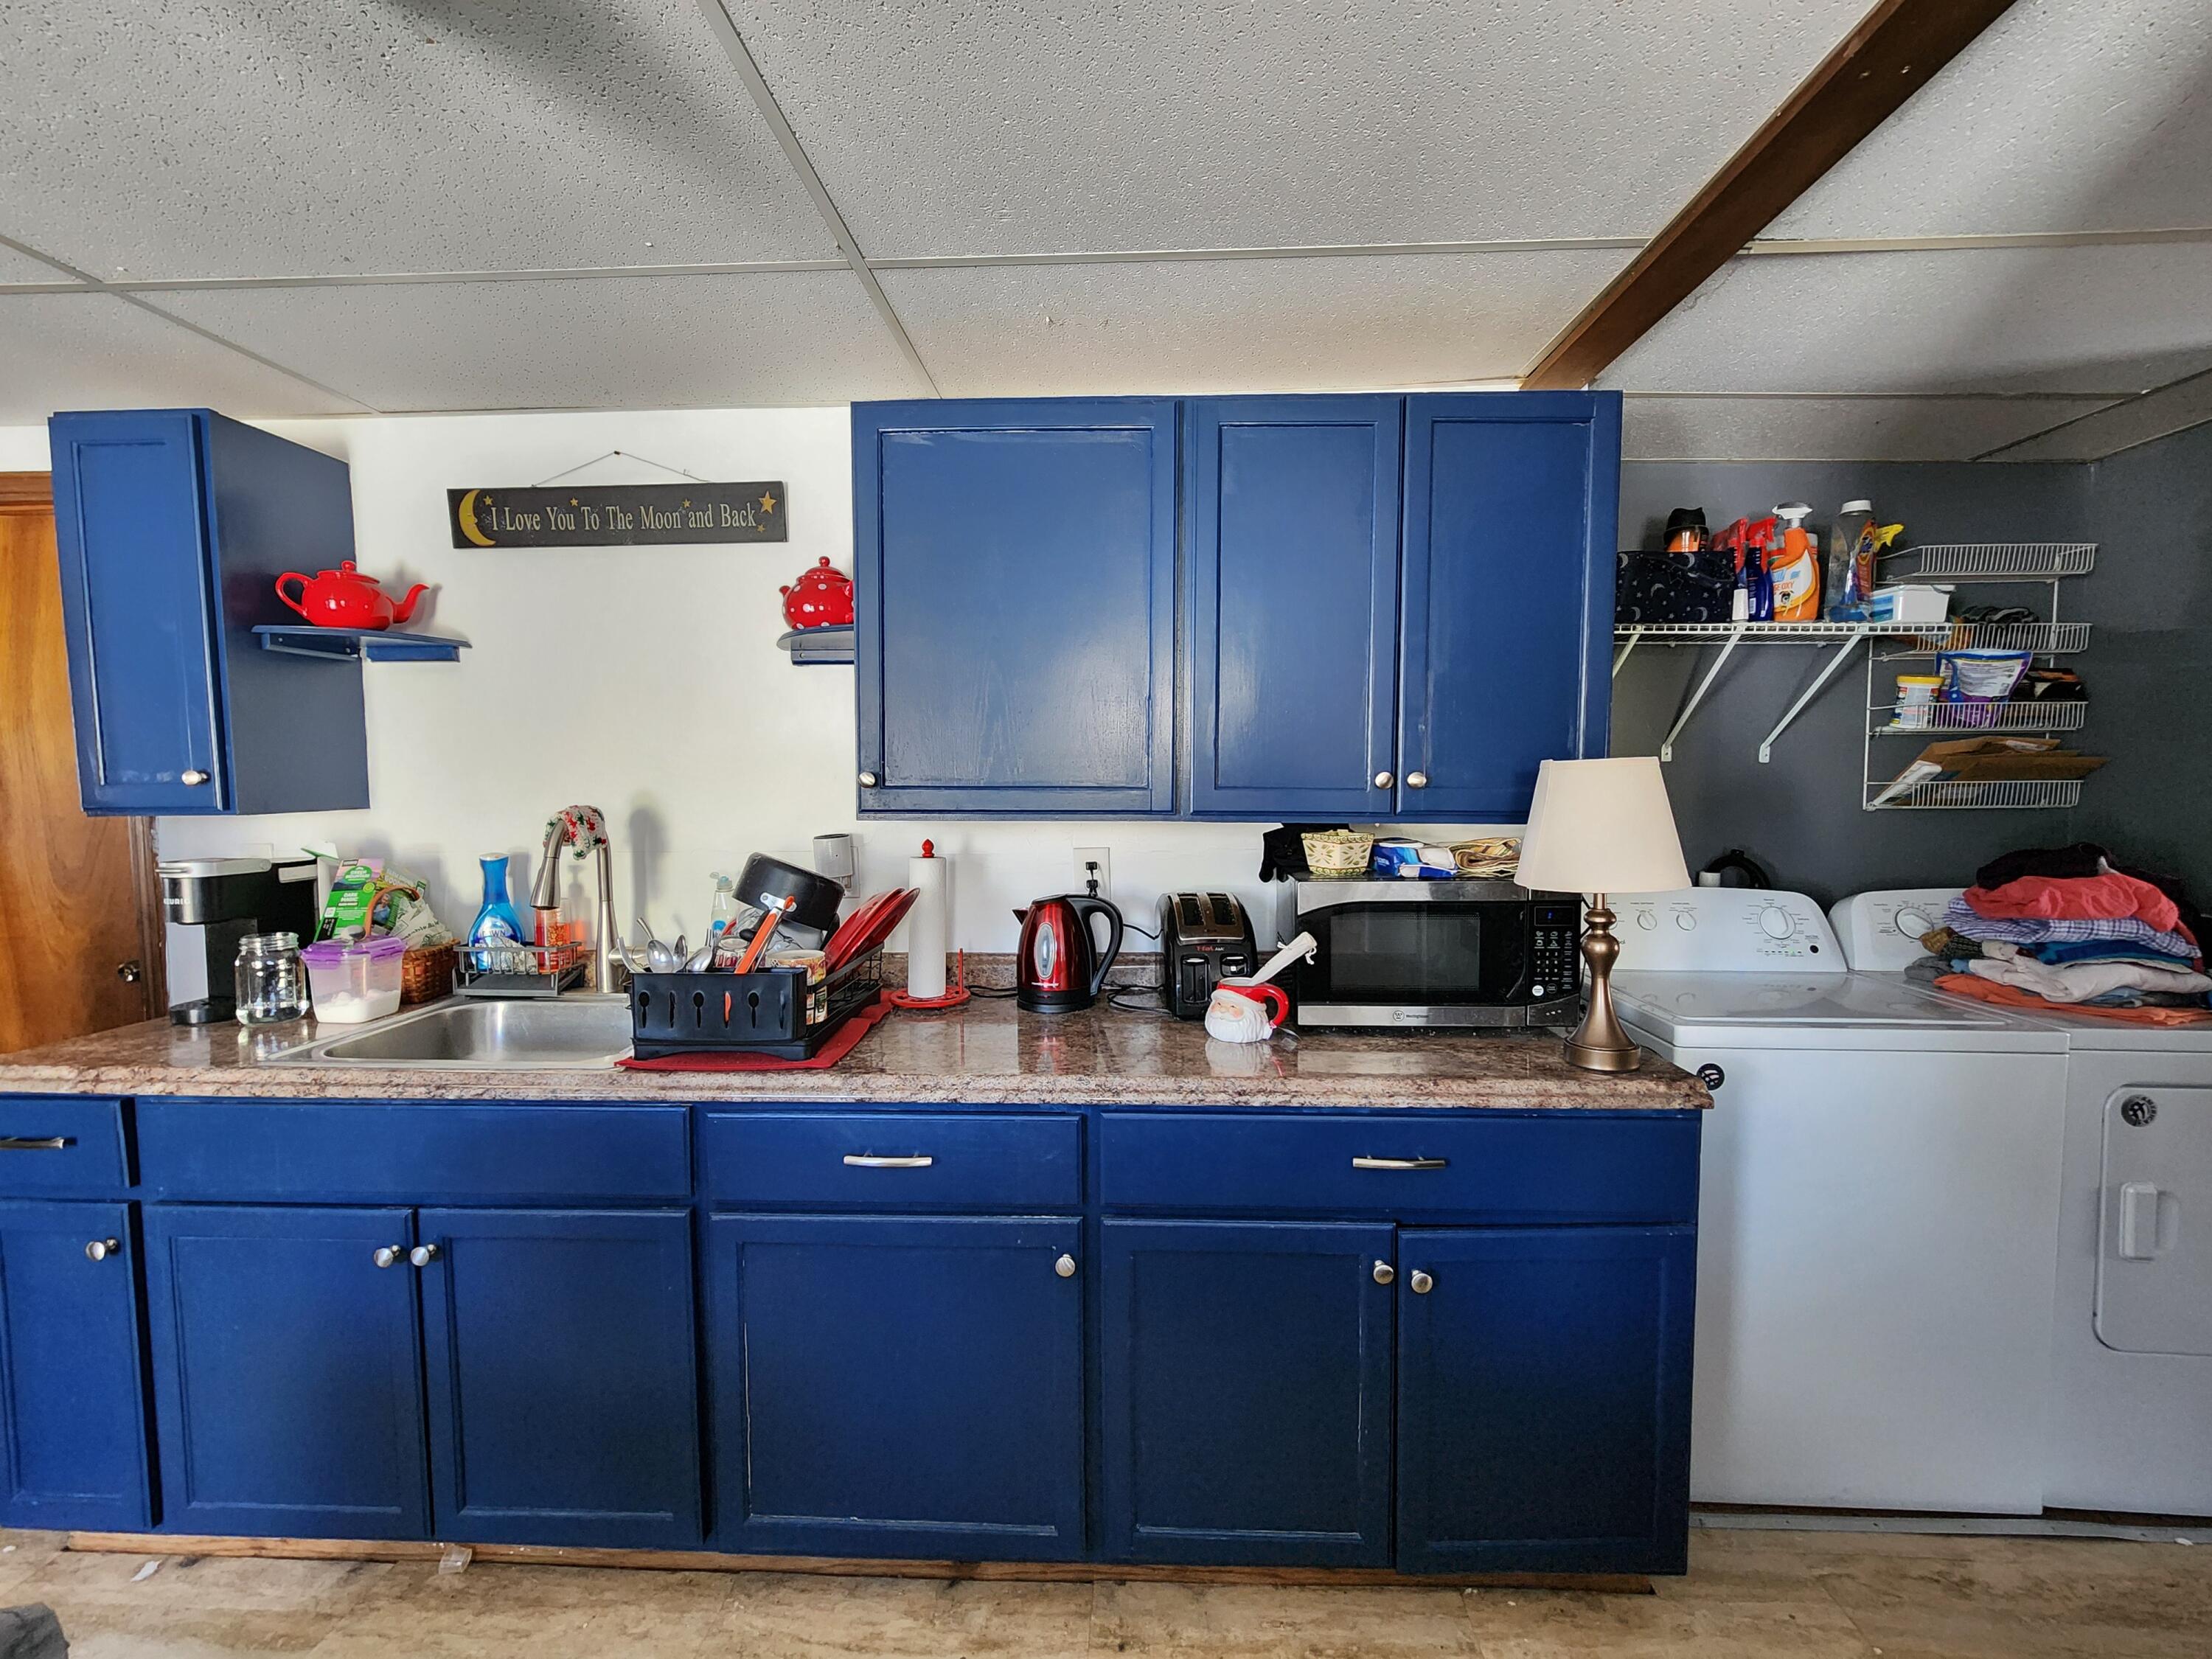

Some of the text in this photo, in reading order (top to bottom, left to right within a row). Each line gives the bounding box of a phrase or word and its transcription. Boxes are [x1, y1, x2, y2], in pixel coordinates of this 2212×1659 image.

[490, 502, 757, 531] I Love You To The Moon and Back
